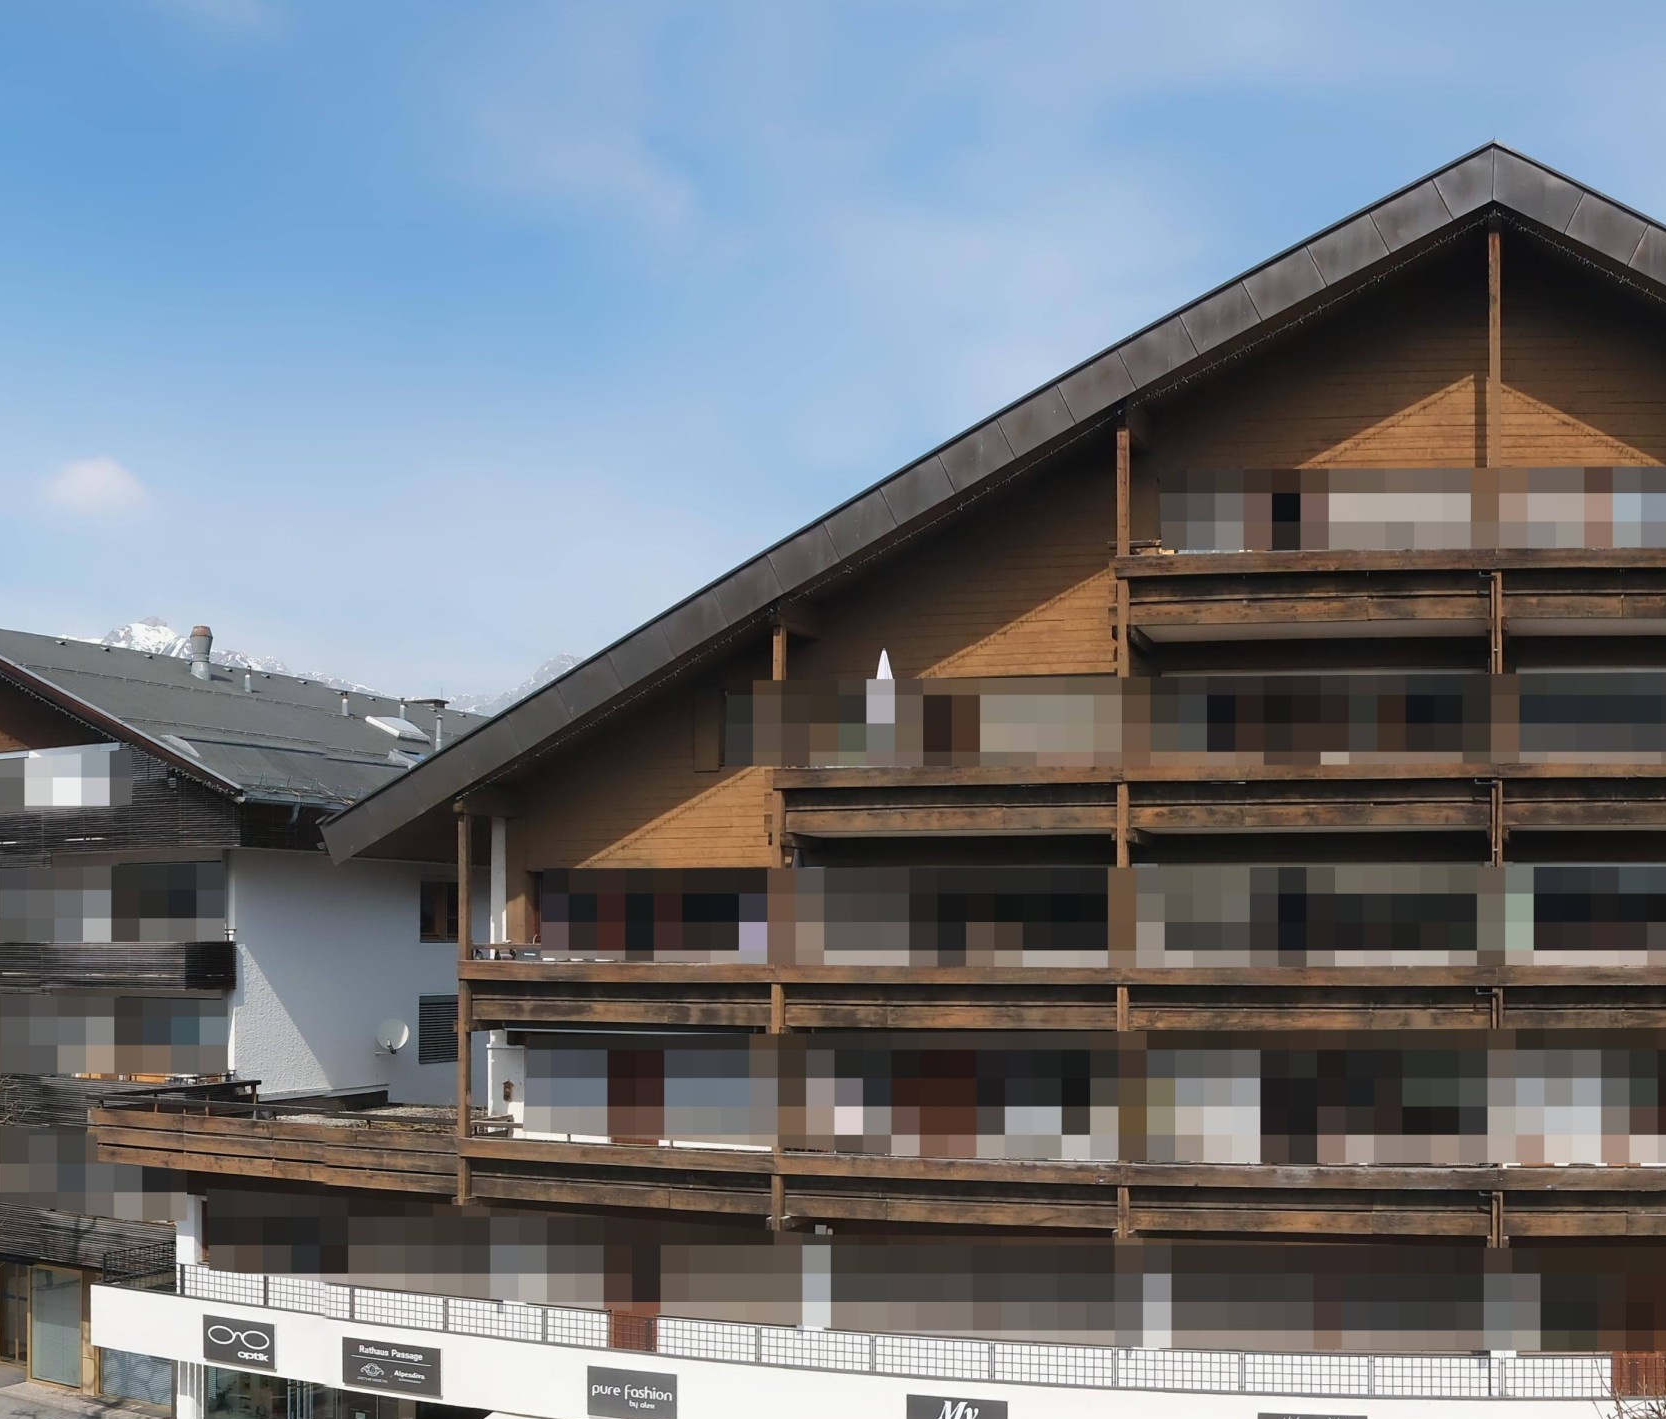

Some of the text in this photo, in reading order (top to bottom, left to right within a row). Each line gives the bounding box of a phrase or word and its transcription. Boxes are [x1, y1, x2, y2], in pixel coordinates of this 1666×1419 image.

[237, 1351, 269, 1362] optik
[359, 1344, 424, 1362] Rathaus Passage
[591, 1384, 673, 1402] pure fashion
[629, 1399, 655, 1410] by alex
